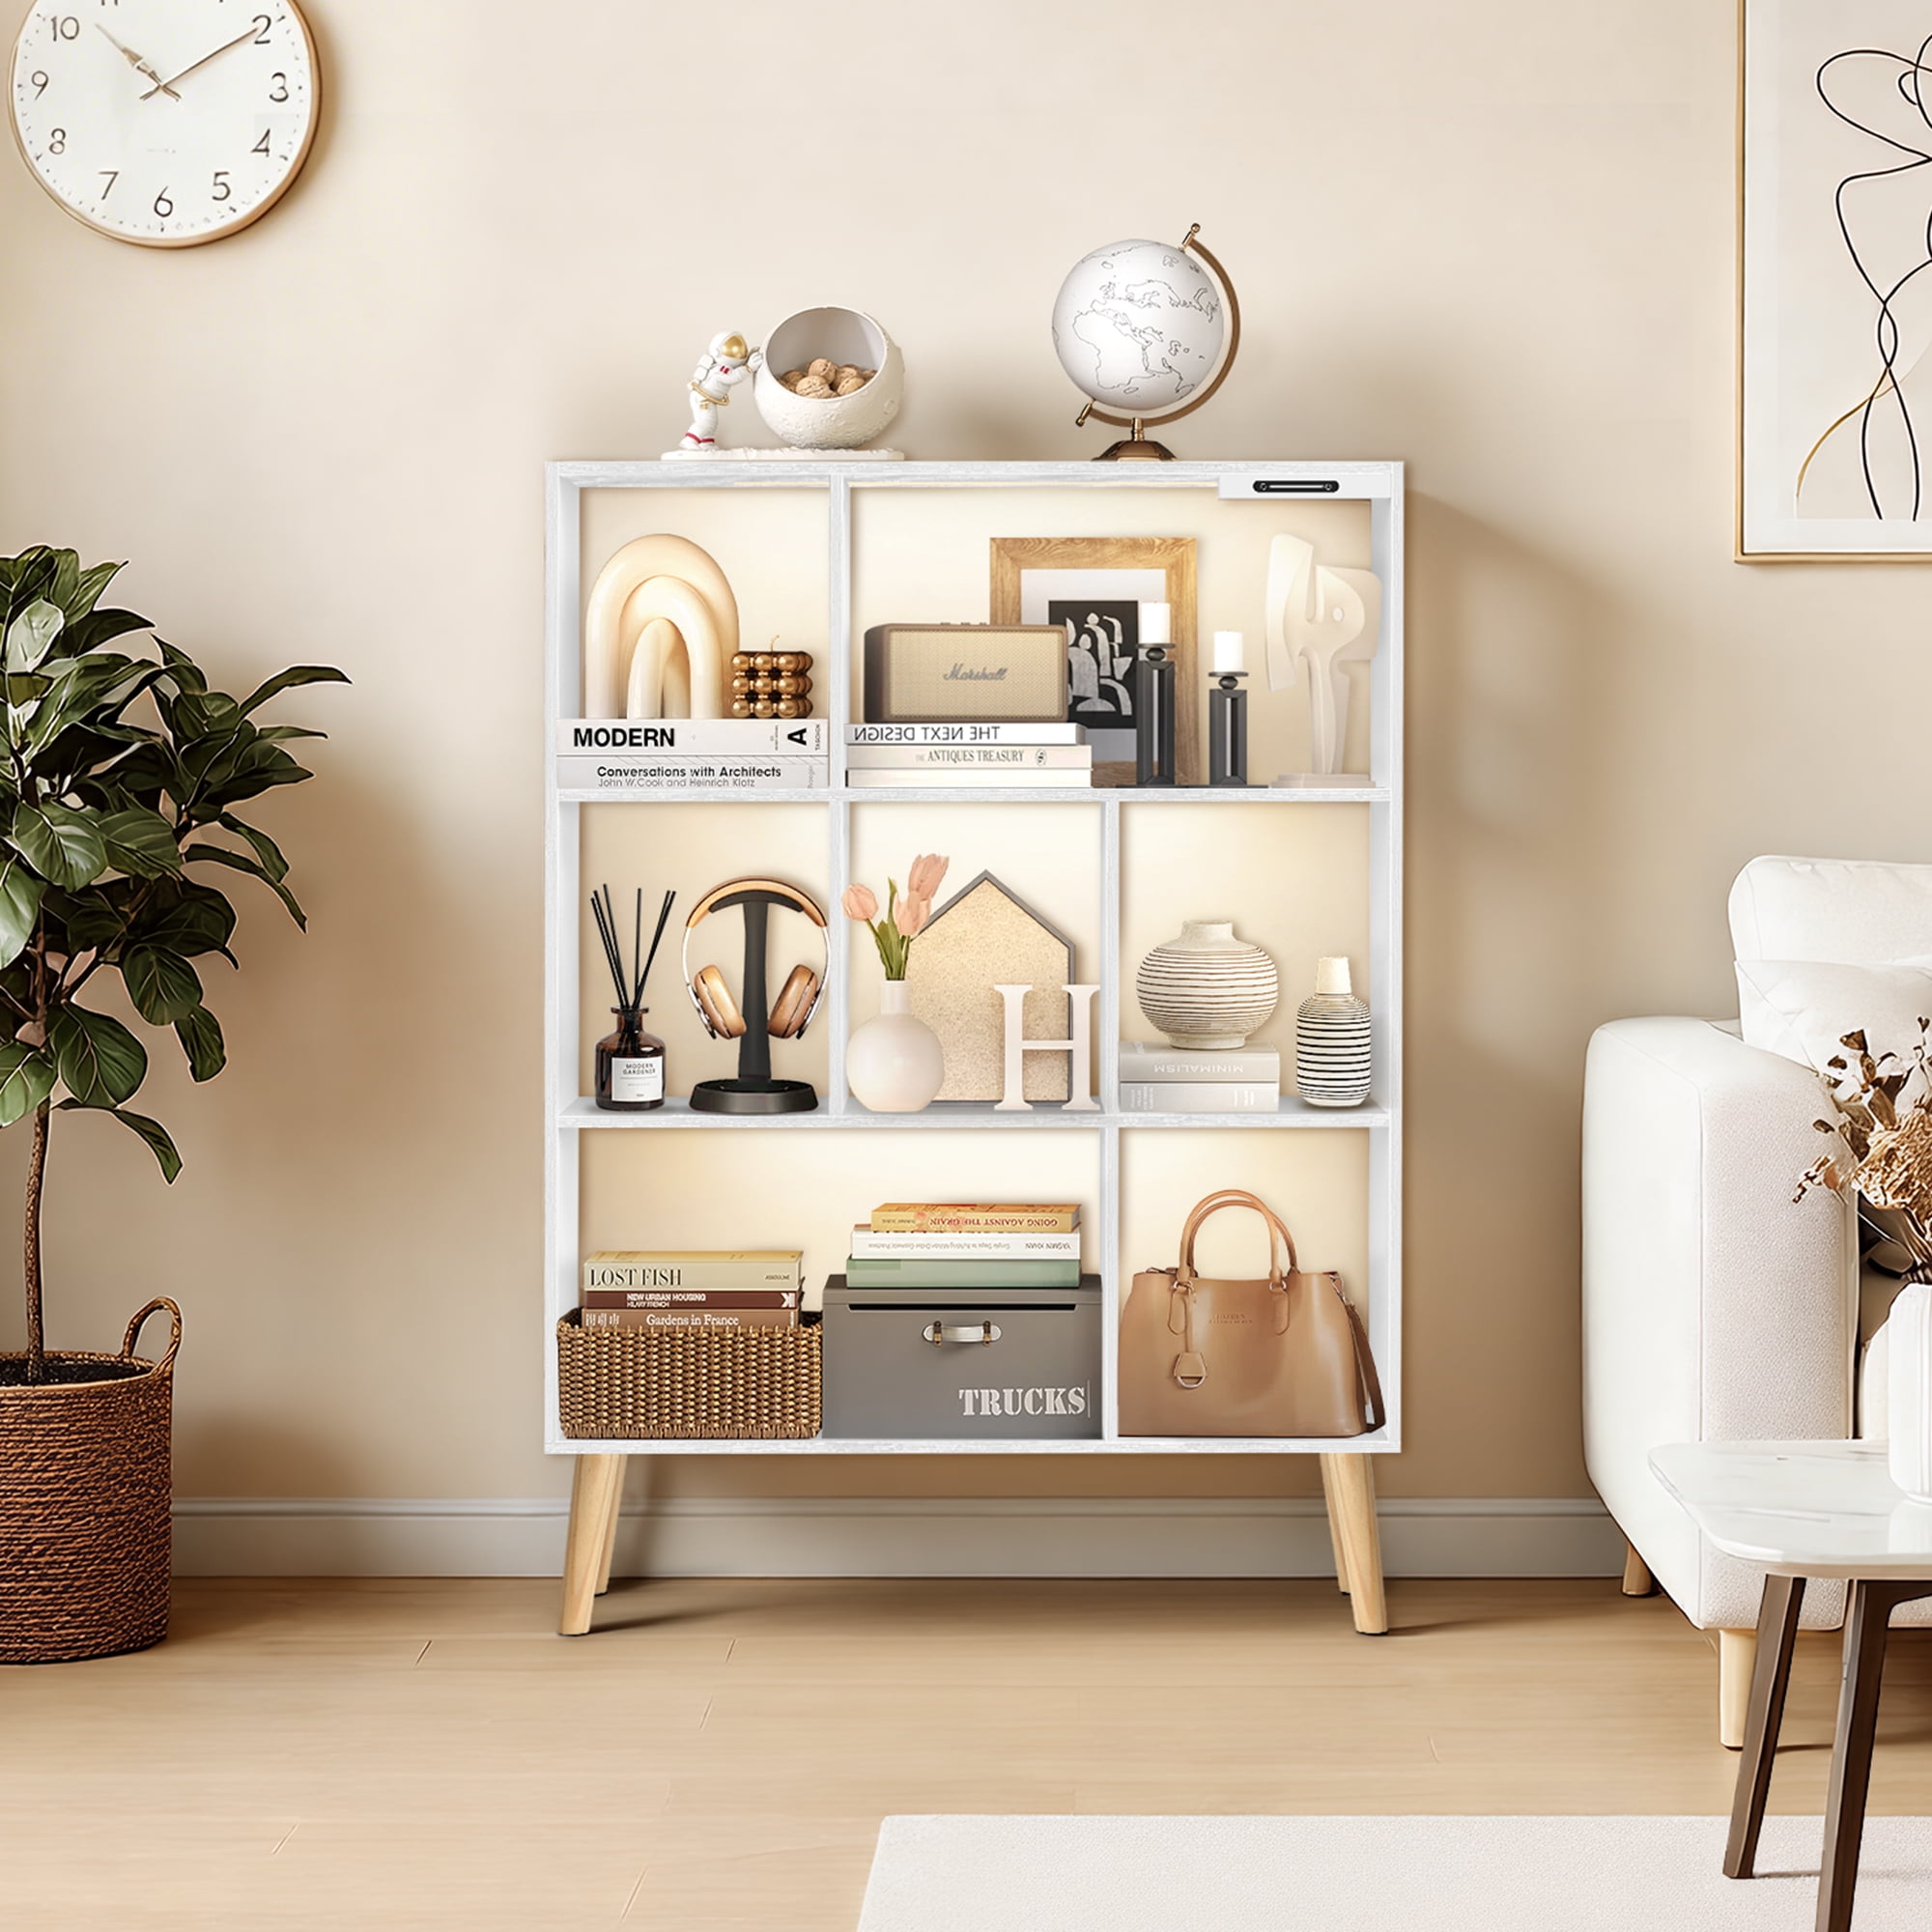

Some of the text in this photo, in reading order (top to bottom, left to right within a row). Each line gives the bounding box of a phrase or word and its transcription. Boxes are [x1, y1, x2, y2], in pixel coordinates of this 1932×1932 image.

[50, 15, 80, 43] 10
[251, 14, 272, 44] 2
[31, 71, 49, 101] 9
[269, 71, 290, 103] 3
[49, 128, 67, 156] 8
[250, 128, 271, 157] 4
[98, 170, 120, 201] 7
[211, 171, 231, 201] 5
[154, 186, 174, 218] 6
[943, 663, 1009, 681] Marshall
[574, 727, 675, 748] MODERN
[786, 727, 808, 746] A
[927, 750, 975, 763] ANTIQUES
[978, 749, 1025, 762] TREASURY
[597, 765, 781, 778] Conversations with Architects
[598, 778, 623, 787] John
[667, 778, 687, 787] and
[689, 778, 730, 787] Heinrich
[993, 984, 1100, 1111] H
[1153, 1065, 1244, 1073] MINIMALISM
[929, 1218, 1058, 1227] GOING AGAINST THE GRAIN
[590, 1268, 682, 1287] LOST FISH
[646, 1314, 739, 1326] Gardens in France
[958, 1387, 1086, 1416] TRUCKS
